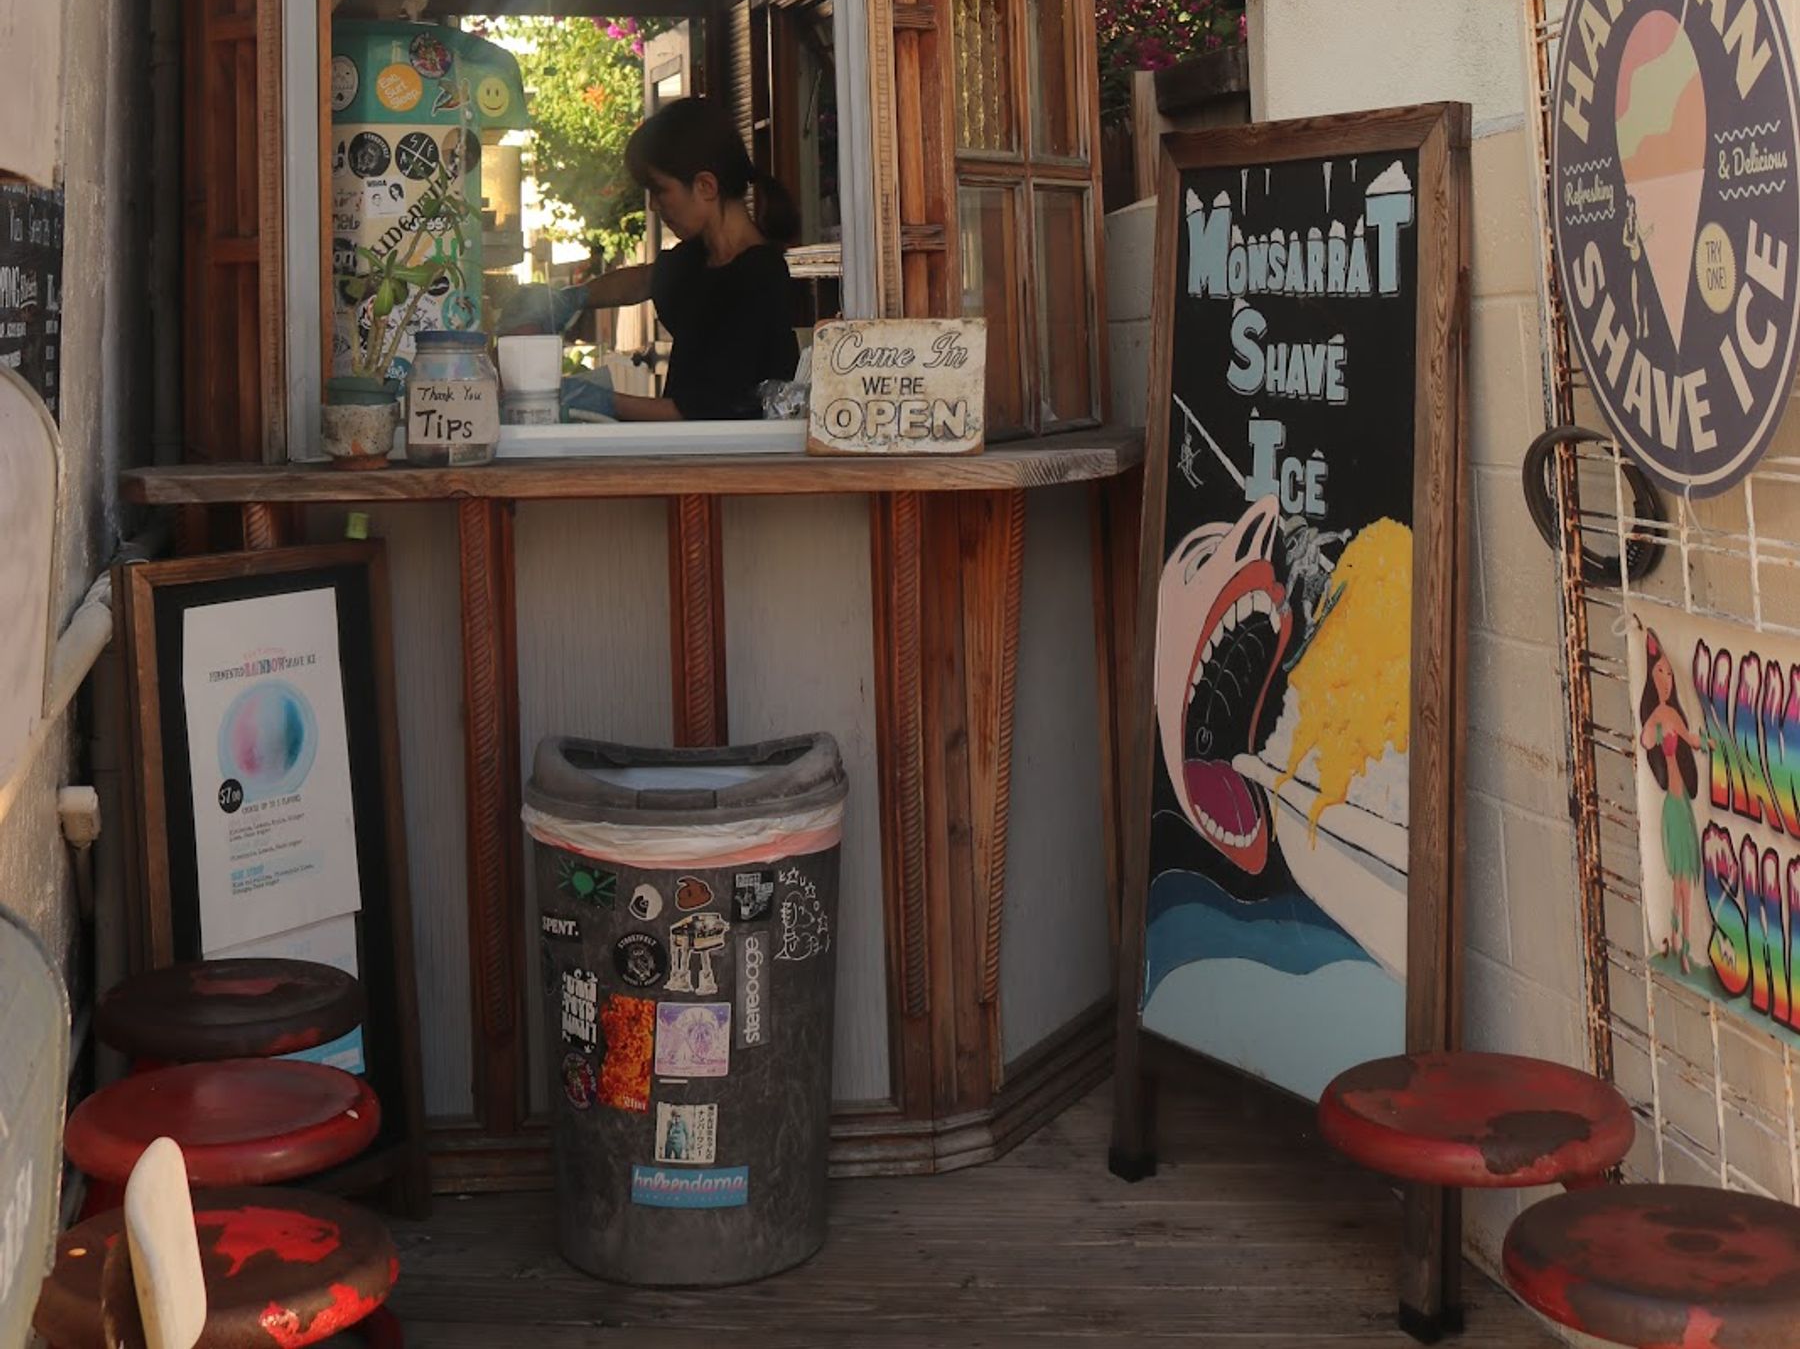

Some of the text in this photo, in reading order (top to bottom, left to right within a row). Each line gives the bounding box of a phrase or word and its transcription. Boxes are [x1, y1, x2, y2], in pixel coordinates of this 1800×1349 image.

[1732, 138, 1789, 177] Delicious
[1564, 179, 1615, 210] Refreshing
[1186, 174, 1415, 298] MONSARRAT
[1705, 239, 1725, 265] TRY
[831, 330, 968, 376] Come In
[1226, 302, 1349, 406] SHAVE
[1573, 219, 1788, 453] SHAVE ICE
[418, 385, 483, 403] Thank You
[862, 376, 925, 396] WE'RE
[416, 410, 474, 441] Tips
[824, 398, 968, 440] OPEN
[1245, 414, 1329, 520] ICE
[542, 916, 579, 936] SPENT.
